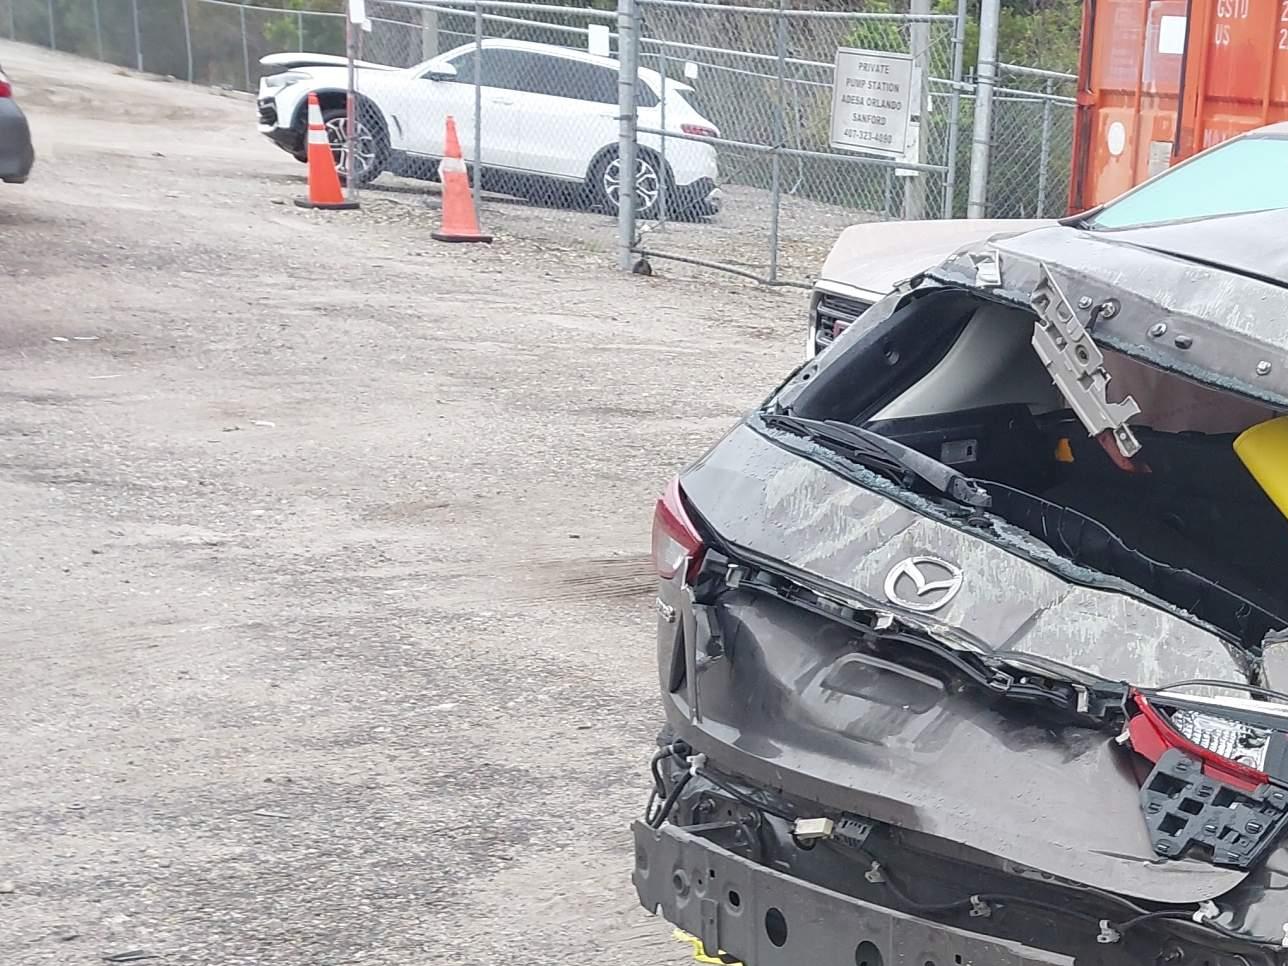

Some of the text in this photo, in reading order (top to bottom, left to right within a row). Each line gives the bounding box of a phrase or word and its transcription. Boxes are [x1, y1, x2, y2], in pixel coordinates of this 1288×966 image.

[1215, 24, 1231, 45] US
[858, 62, 890, 74] PRIVATE
[846, 77, 900, 93] PUMP STATION
[841, 94, 902, 110] ADESA ORLANDO
[852, 112, 887, 126] SANFORD
